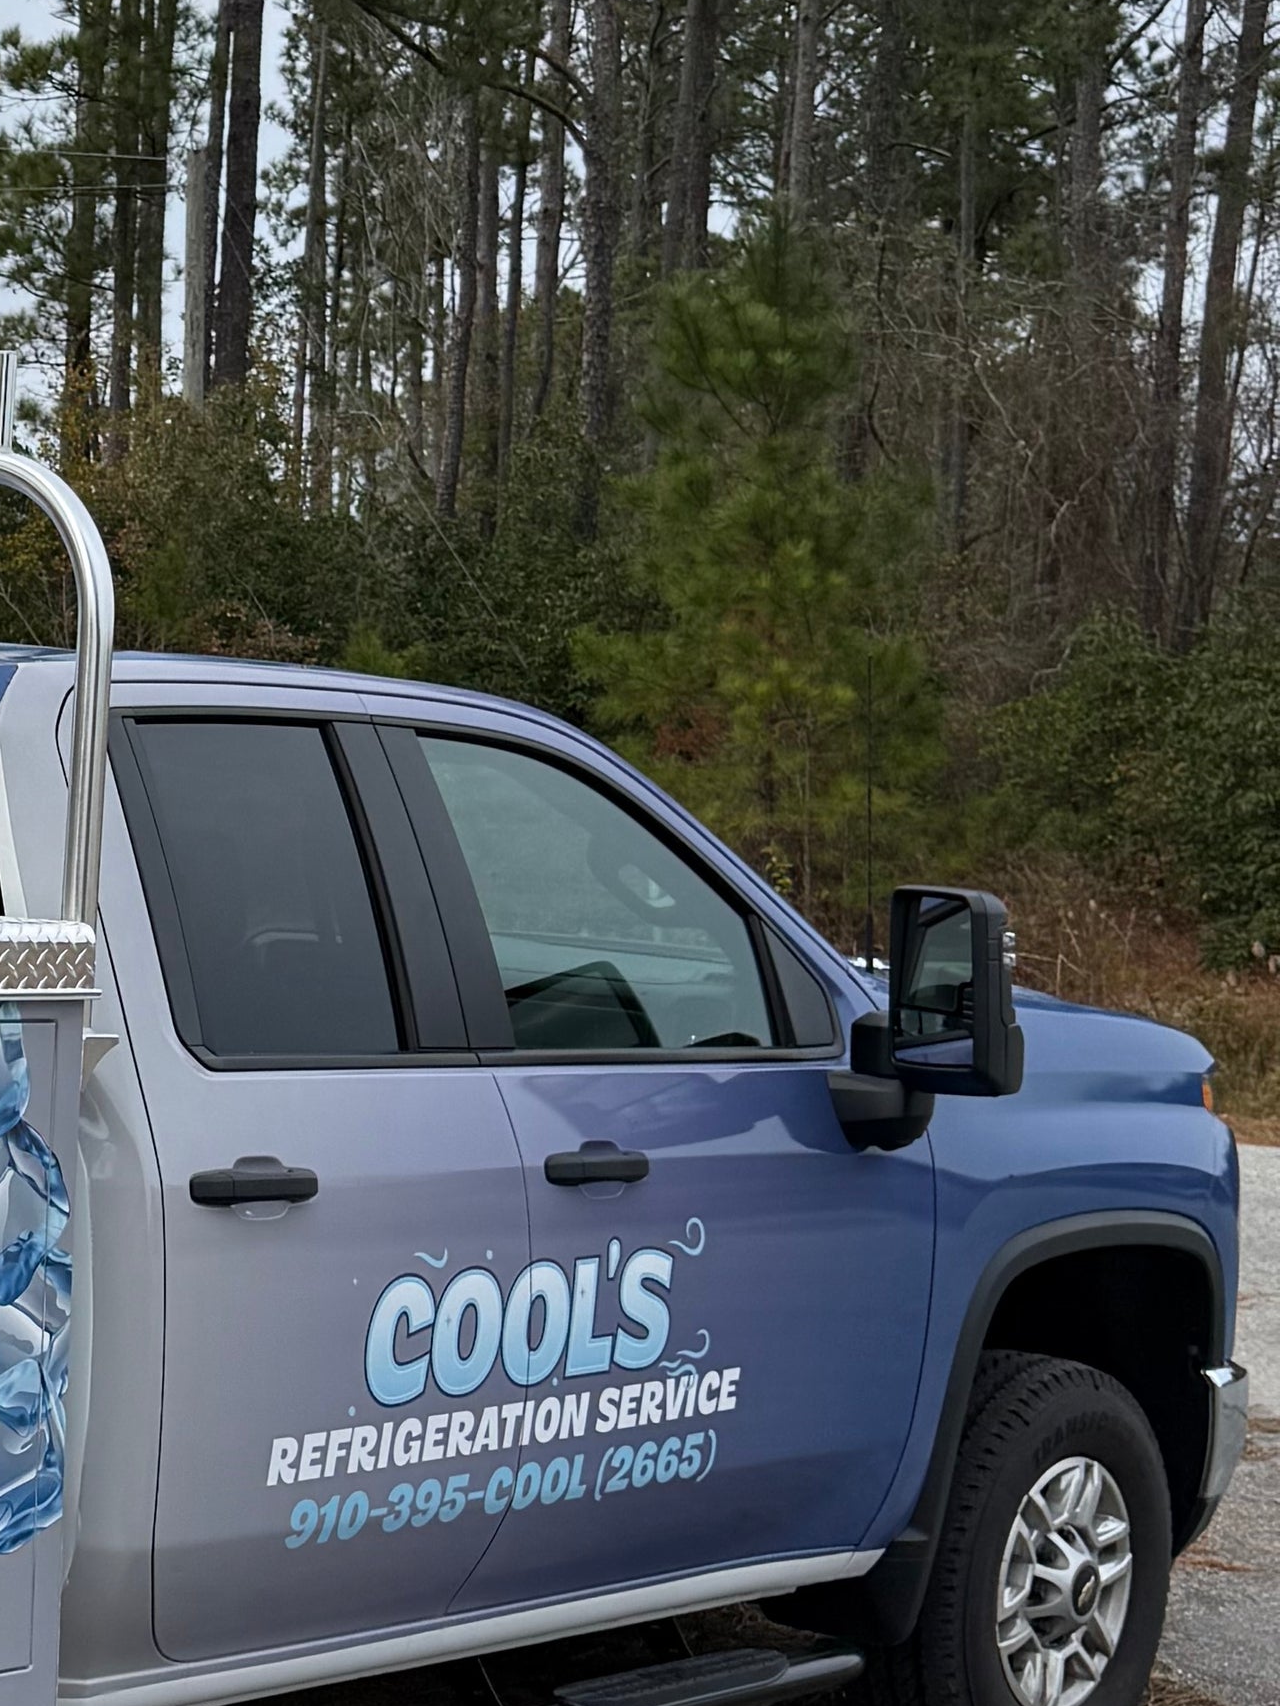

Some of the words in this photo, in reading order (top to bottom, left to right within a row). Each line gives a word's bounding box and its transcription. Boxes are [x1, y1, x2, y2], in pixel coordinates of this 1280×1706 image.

[364, 1236, 676, 1407] COOL'S
[266, 1391, 590, 1487] REFRIGERATION
[595, 1367, 741, 1434] SERVICE
[284, 1454, 587, 1550] 910-395-COOL
[594, 1428, 717, 1502] (2665)
